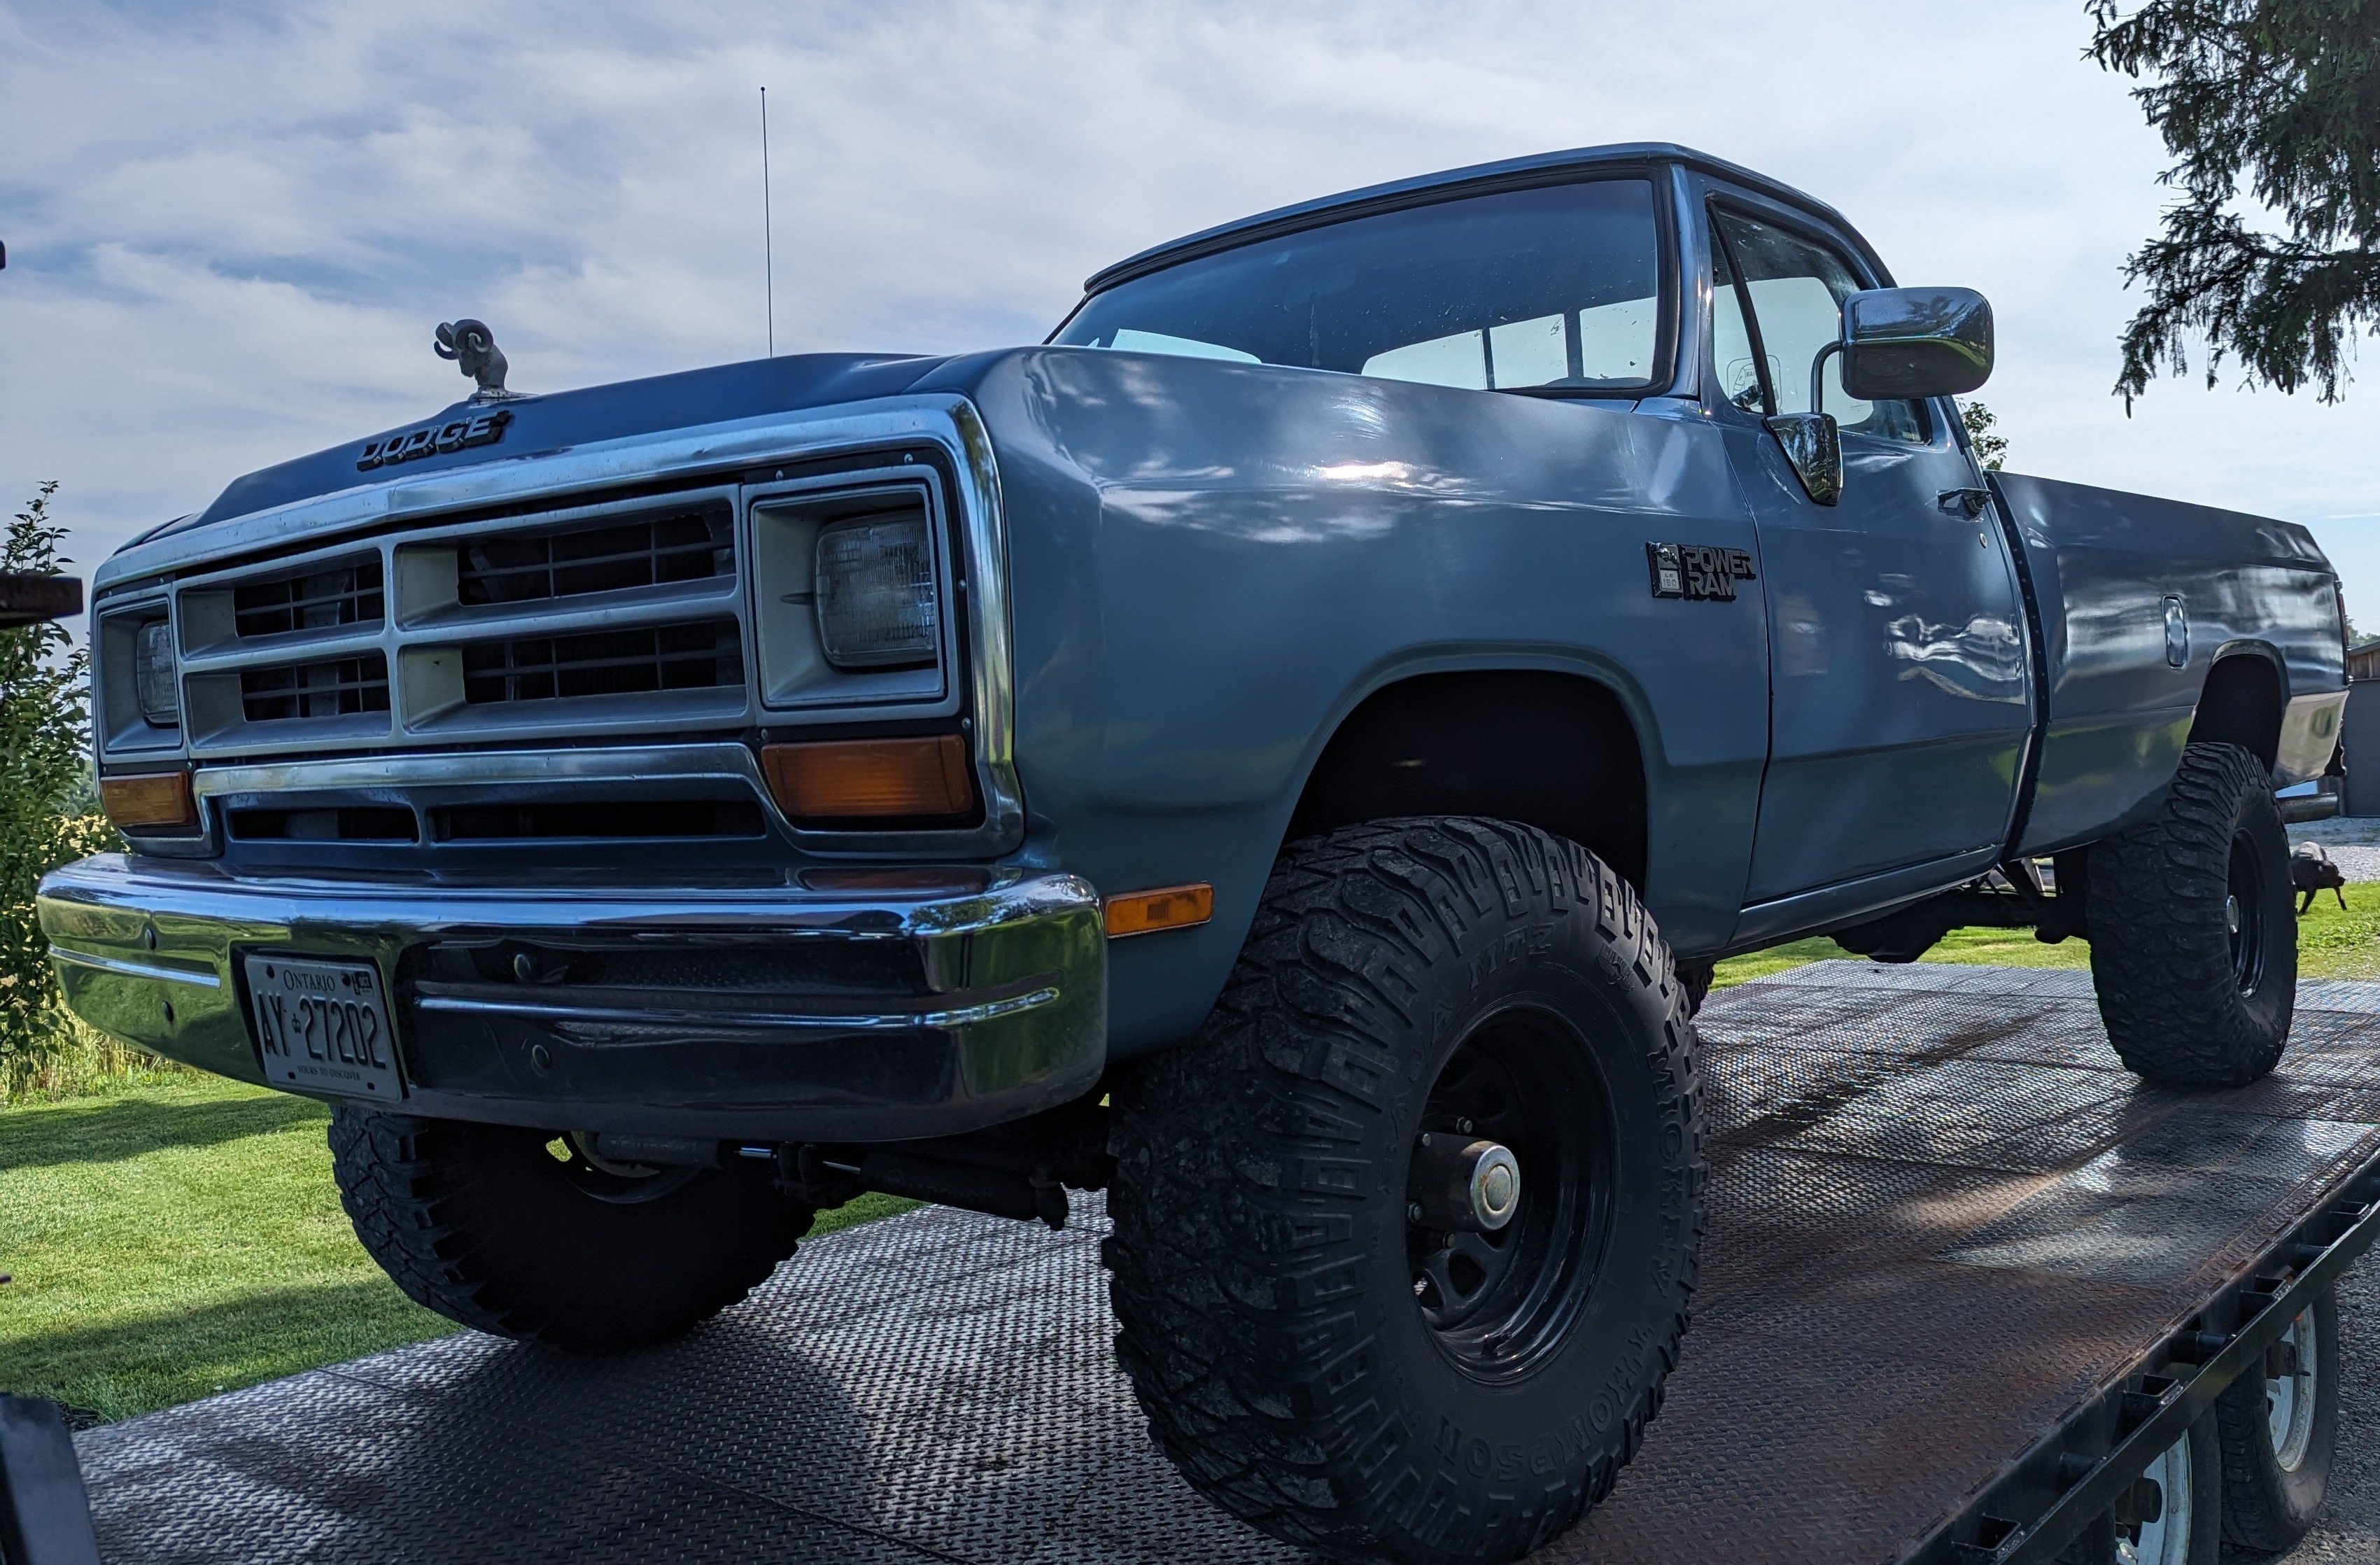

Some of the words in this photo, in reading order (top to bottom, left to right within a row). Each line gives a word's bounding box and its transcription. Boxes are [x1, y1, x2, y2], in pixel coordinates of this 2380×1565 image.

[356, 410, 509, 471] DODGE
[1663, 578, 1677, 587] 150
[1683, 547, 1755, 578] POWER
[1687, 571, 1737, 600] RAM
[1467, 922, 1556, 992] MTZ
[283, 969, 335, 992] ONTARIO
[256, 990, 290, 1056] AY
[300, 994, 386, 1069] 27202
[297, 1065, 318, 1075] YOURS
[319, 1067, 328, 1076] TO
[329, 1069, 360, 1081] DISCOVER
[1647, 1046, 1684, 1298] MICKEY
[1433, 1325, 1656, 1482] THOMPSON
